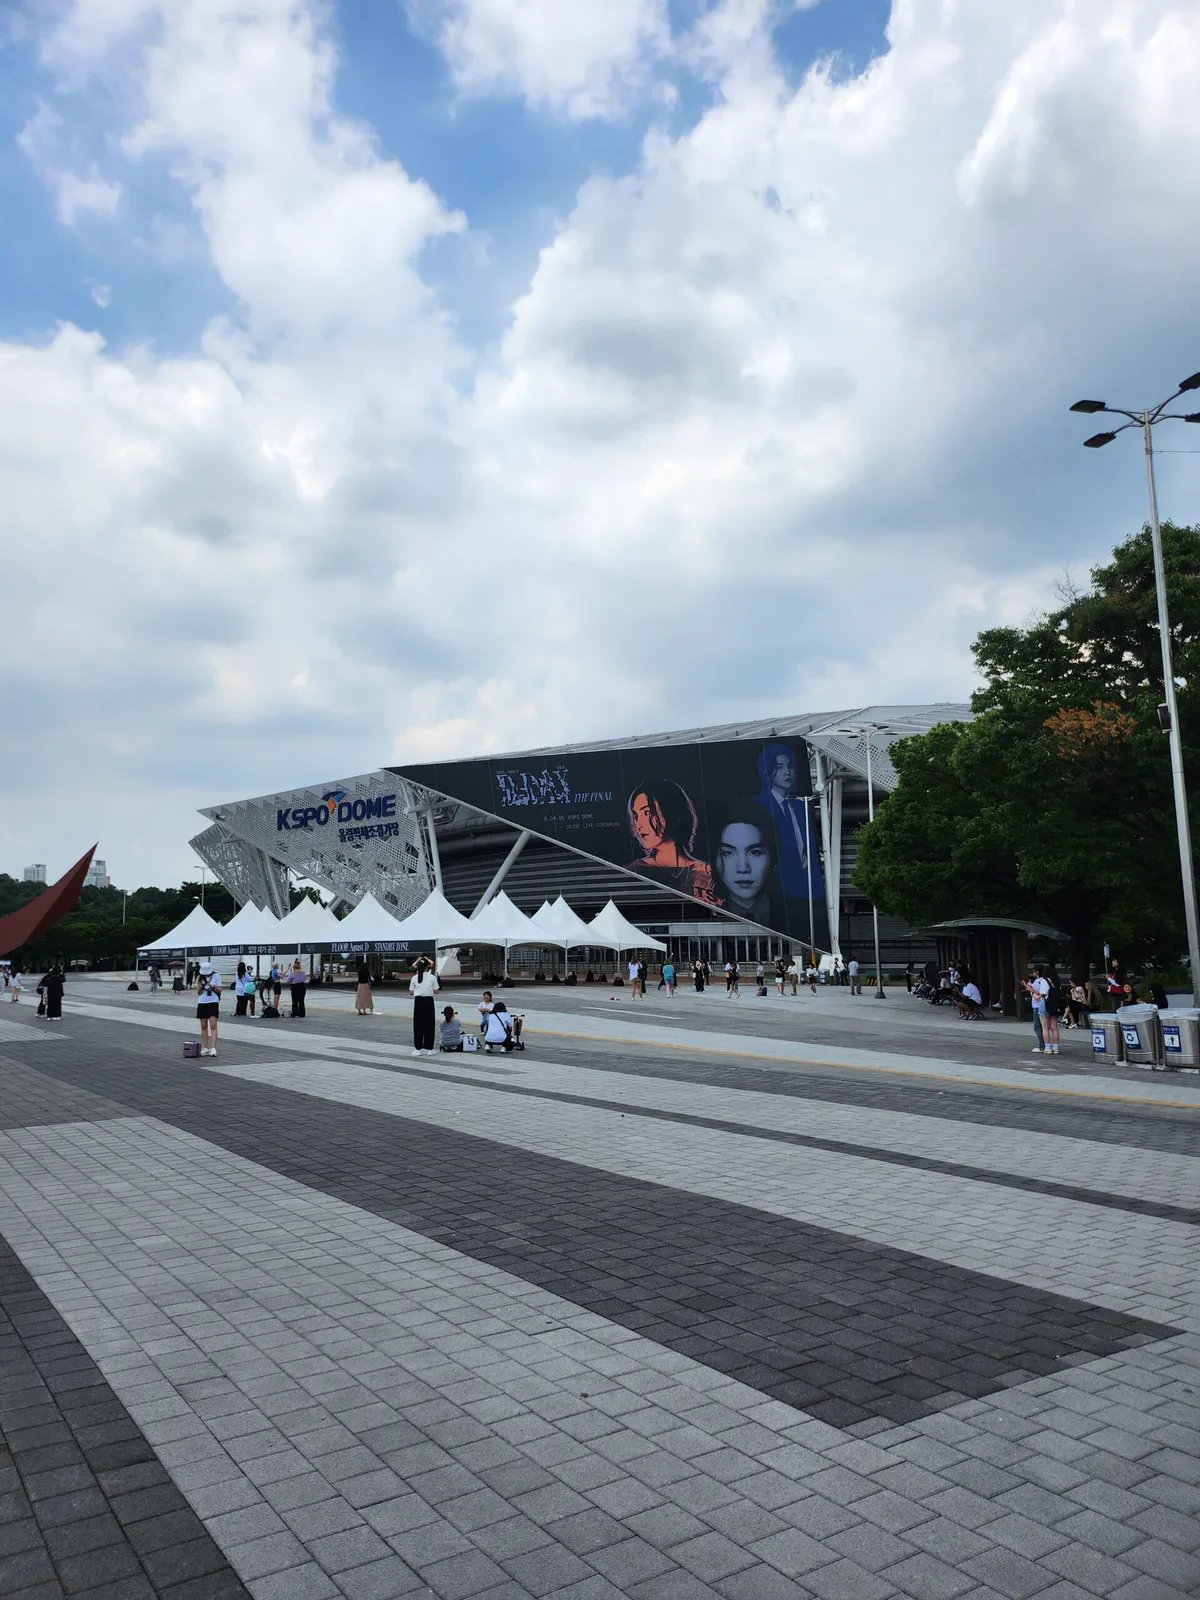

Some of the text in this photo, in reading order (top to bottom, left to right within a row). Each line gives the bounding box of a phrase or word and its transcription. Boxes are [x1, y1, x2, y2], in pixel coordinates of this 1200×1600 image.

[574, 791, 613, 803] THE FINAL
[277, 795, 396, 831] KSPO DOME
[338, 823, 399, 842] 올림픽체조경기장
[212, 945, 244, 955] FLOOR Agust D
[257, 945, 267, 954] 대기
[267, 945, 277, 954] 공간
[331, 941, 370, 953] FLOOR Agust D
[374, 941, 410, 952] STANDBY ZONE
